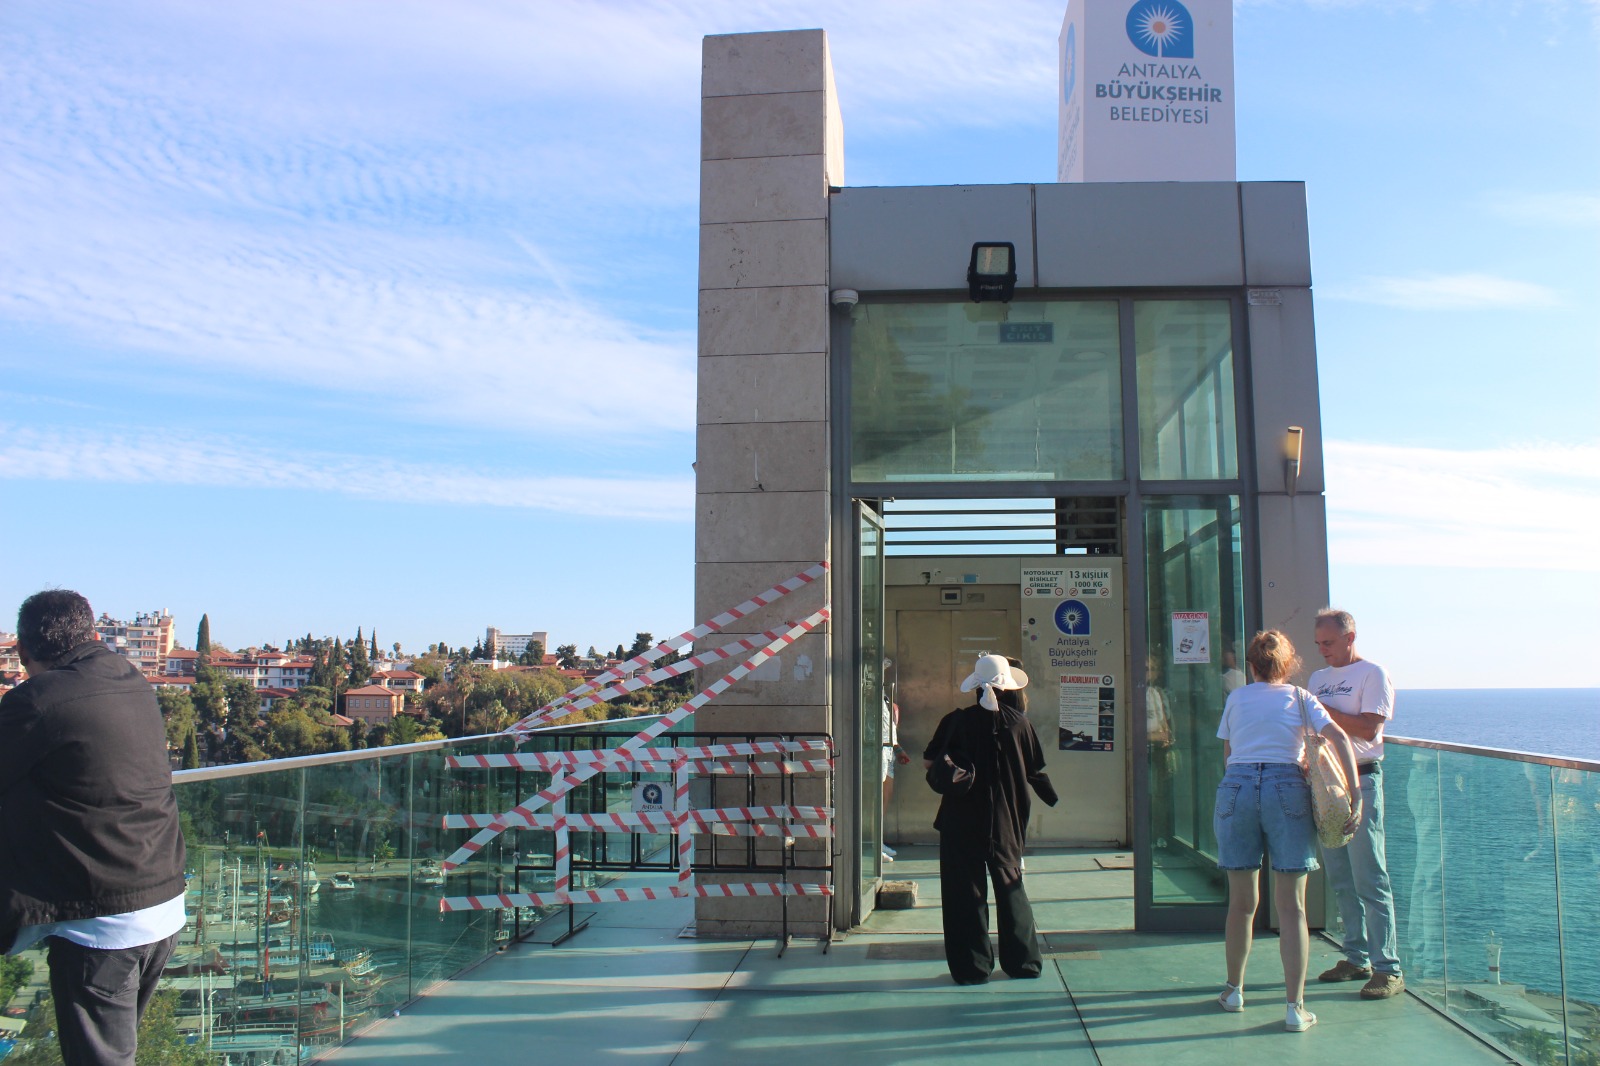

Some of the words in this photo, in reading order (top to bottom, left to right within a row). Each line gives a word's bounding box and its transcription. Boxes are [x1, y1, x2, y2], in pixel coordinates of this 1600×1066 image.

[1117, 62, 1202, 80] ANTALYA
[1095, 79, 1222, 105] BÜYÜKŞEHİR
[1110, 104, 1209, 125] BELEDİYESİ
[1069, 570, 1080, 579] 13
[1082, 570, 1109, 580] KİŞİLİK
[1056, 638, 1090, 647] Antalya
[1048, 647, 1098, 658] Büyükşehir
[1051, 658, 1096, 668] Belediyesi
